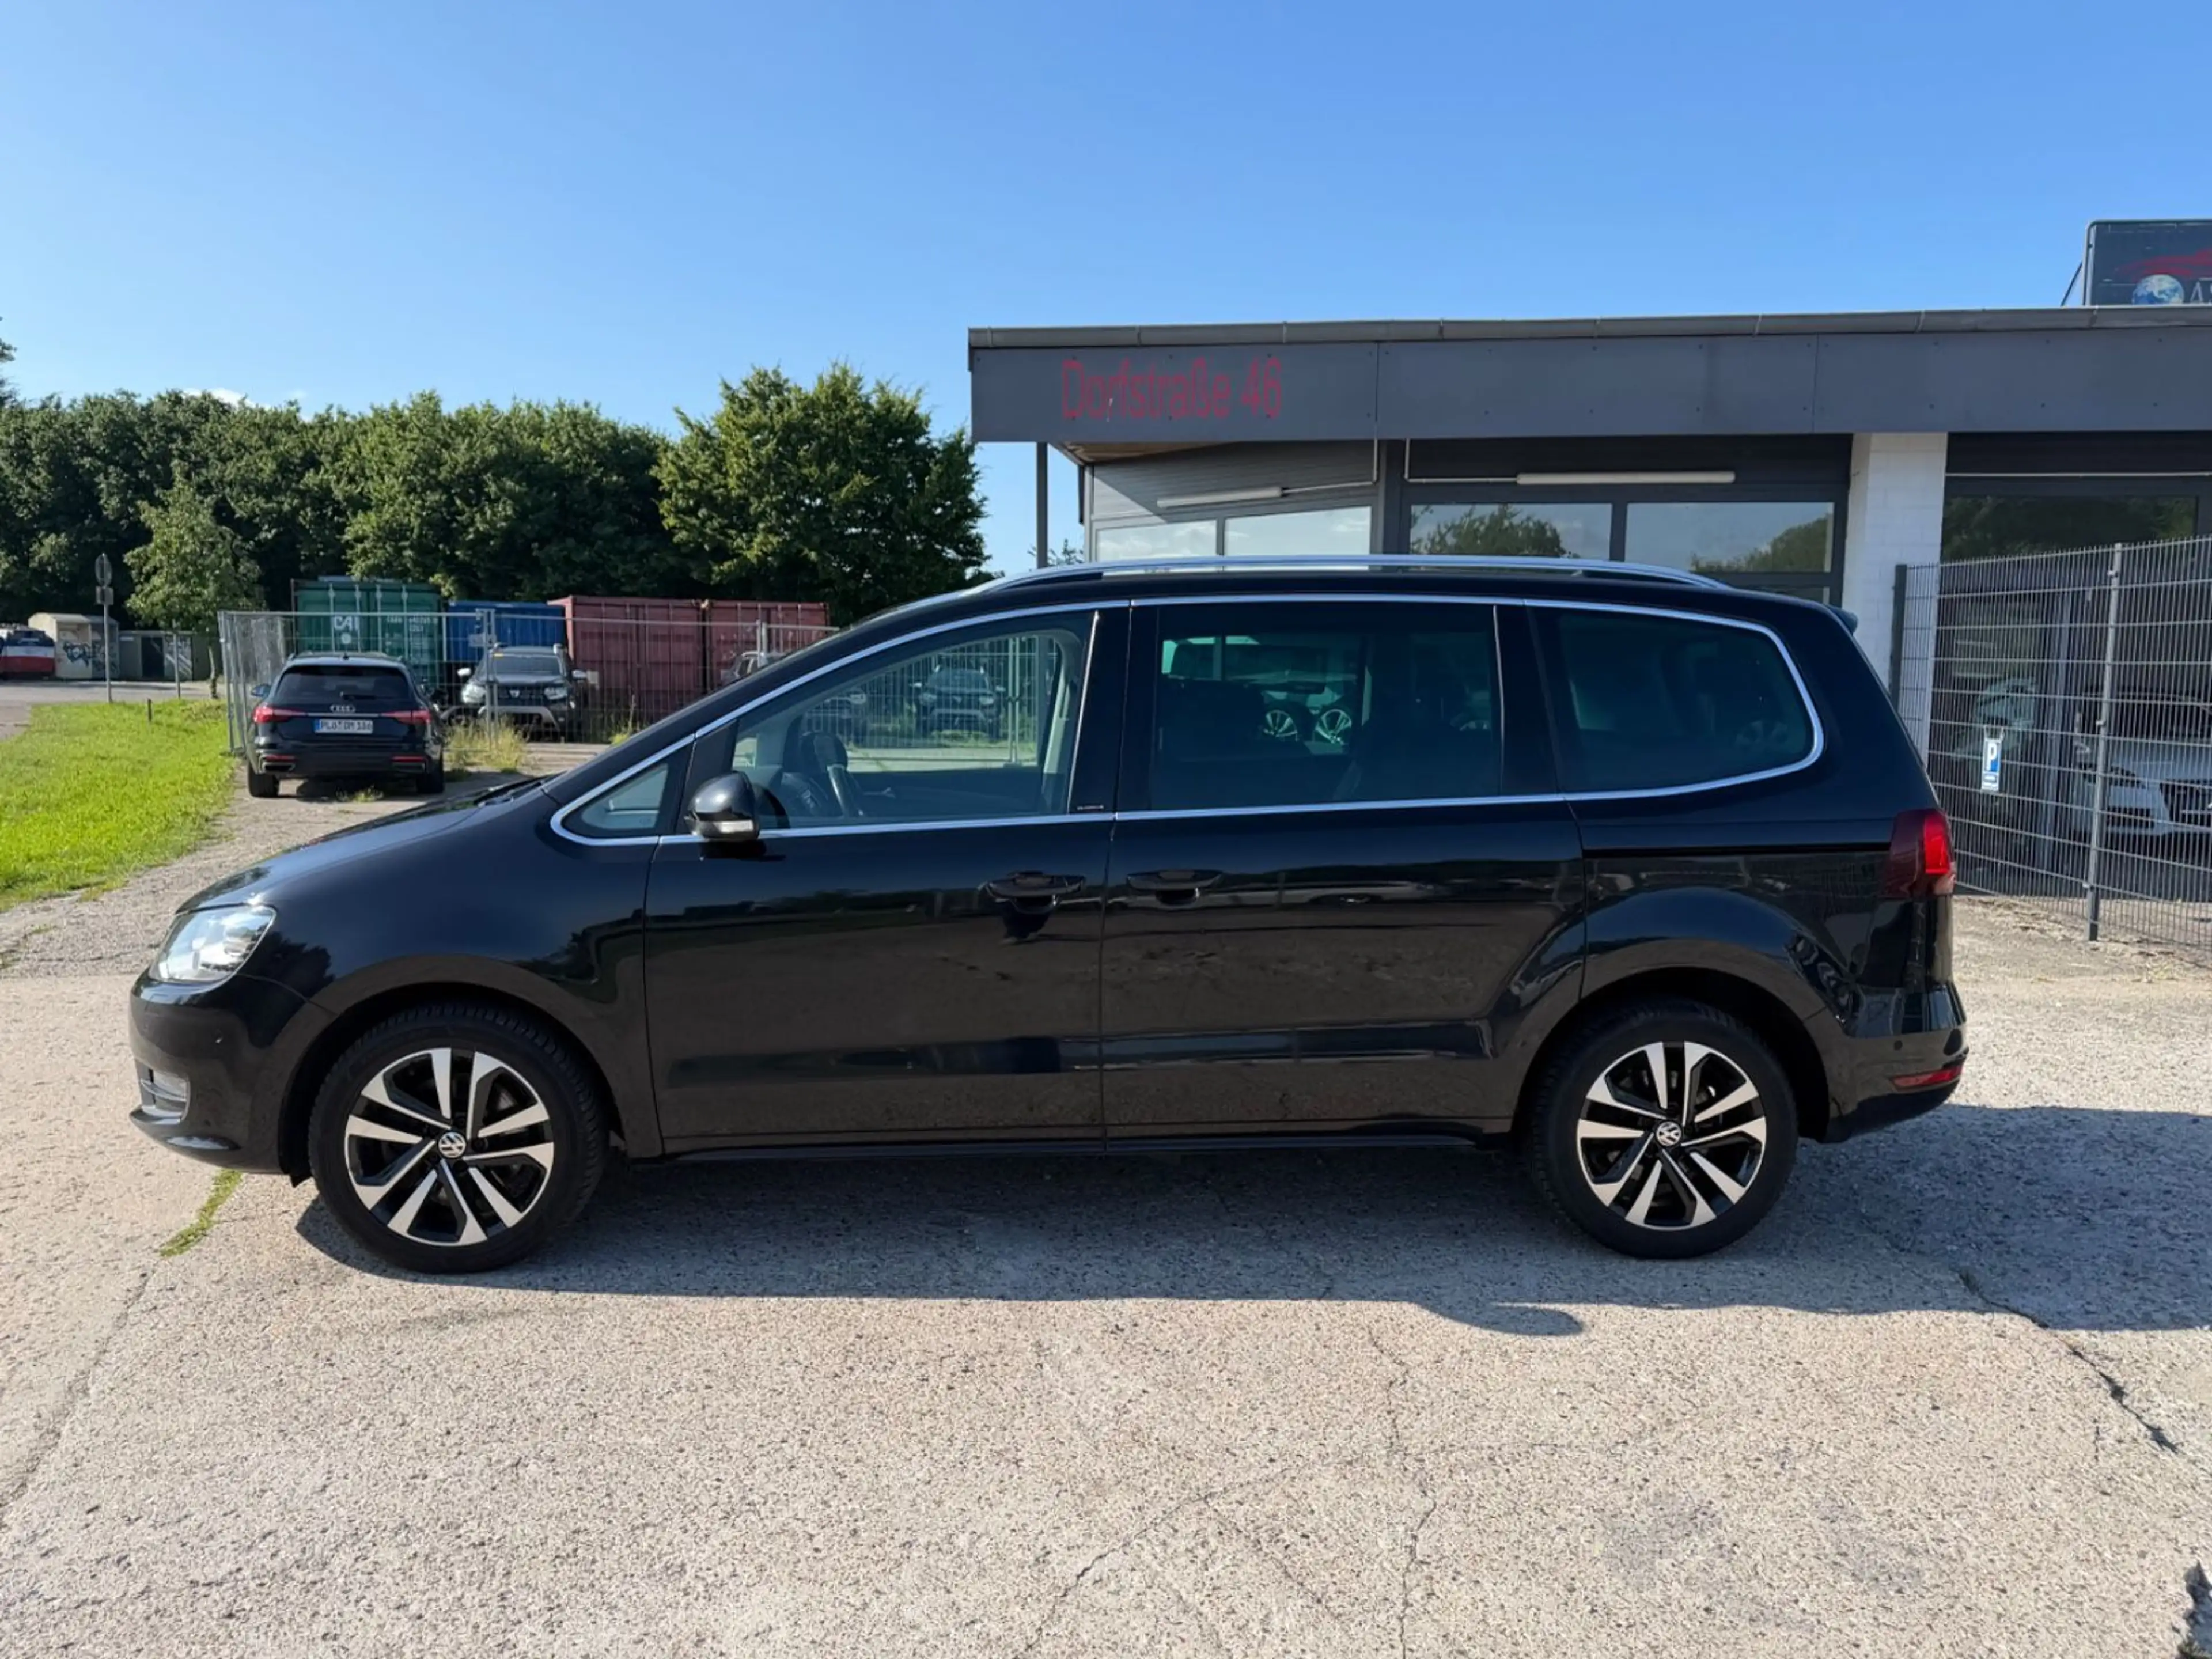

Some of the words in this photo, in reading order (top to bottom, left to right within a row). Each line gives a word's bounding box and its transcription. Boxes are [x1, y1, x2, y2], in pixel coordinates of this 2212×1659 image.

[2190, 281, 2212, 304] A
[1062, 357, 1232, 419] Dorfstraße
[1241, 355, 1282, 419] 46
[1987, 742, 1997, 771] P
